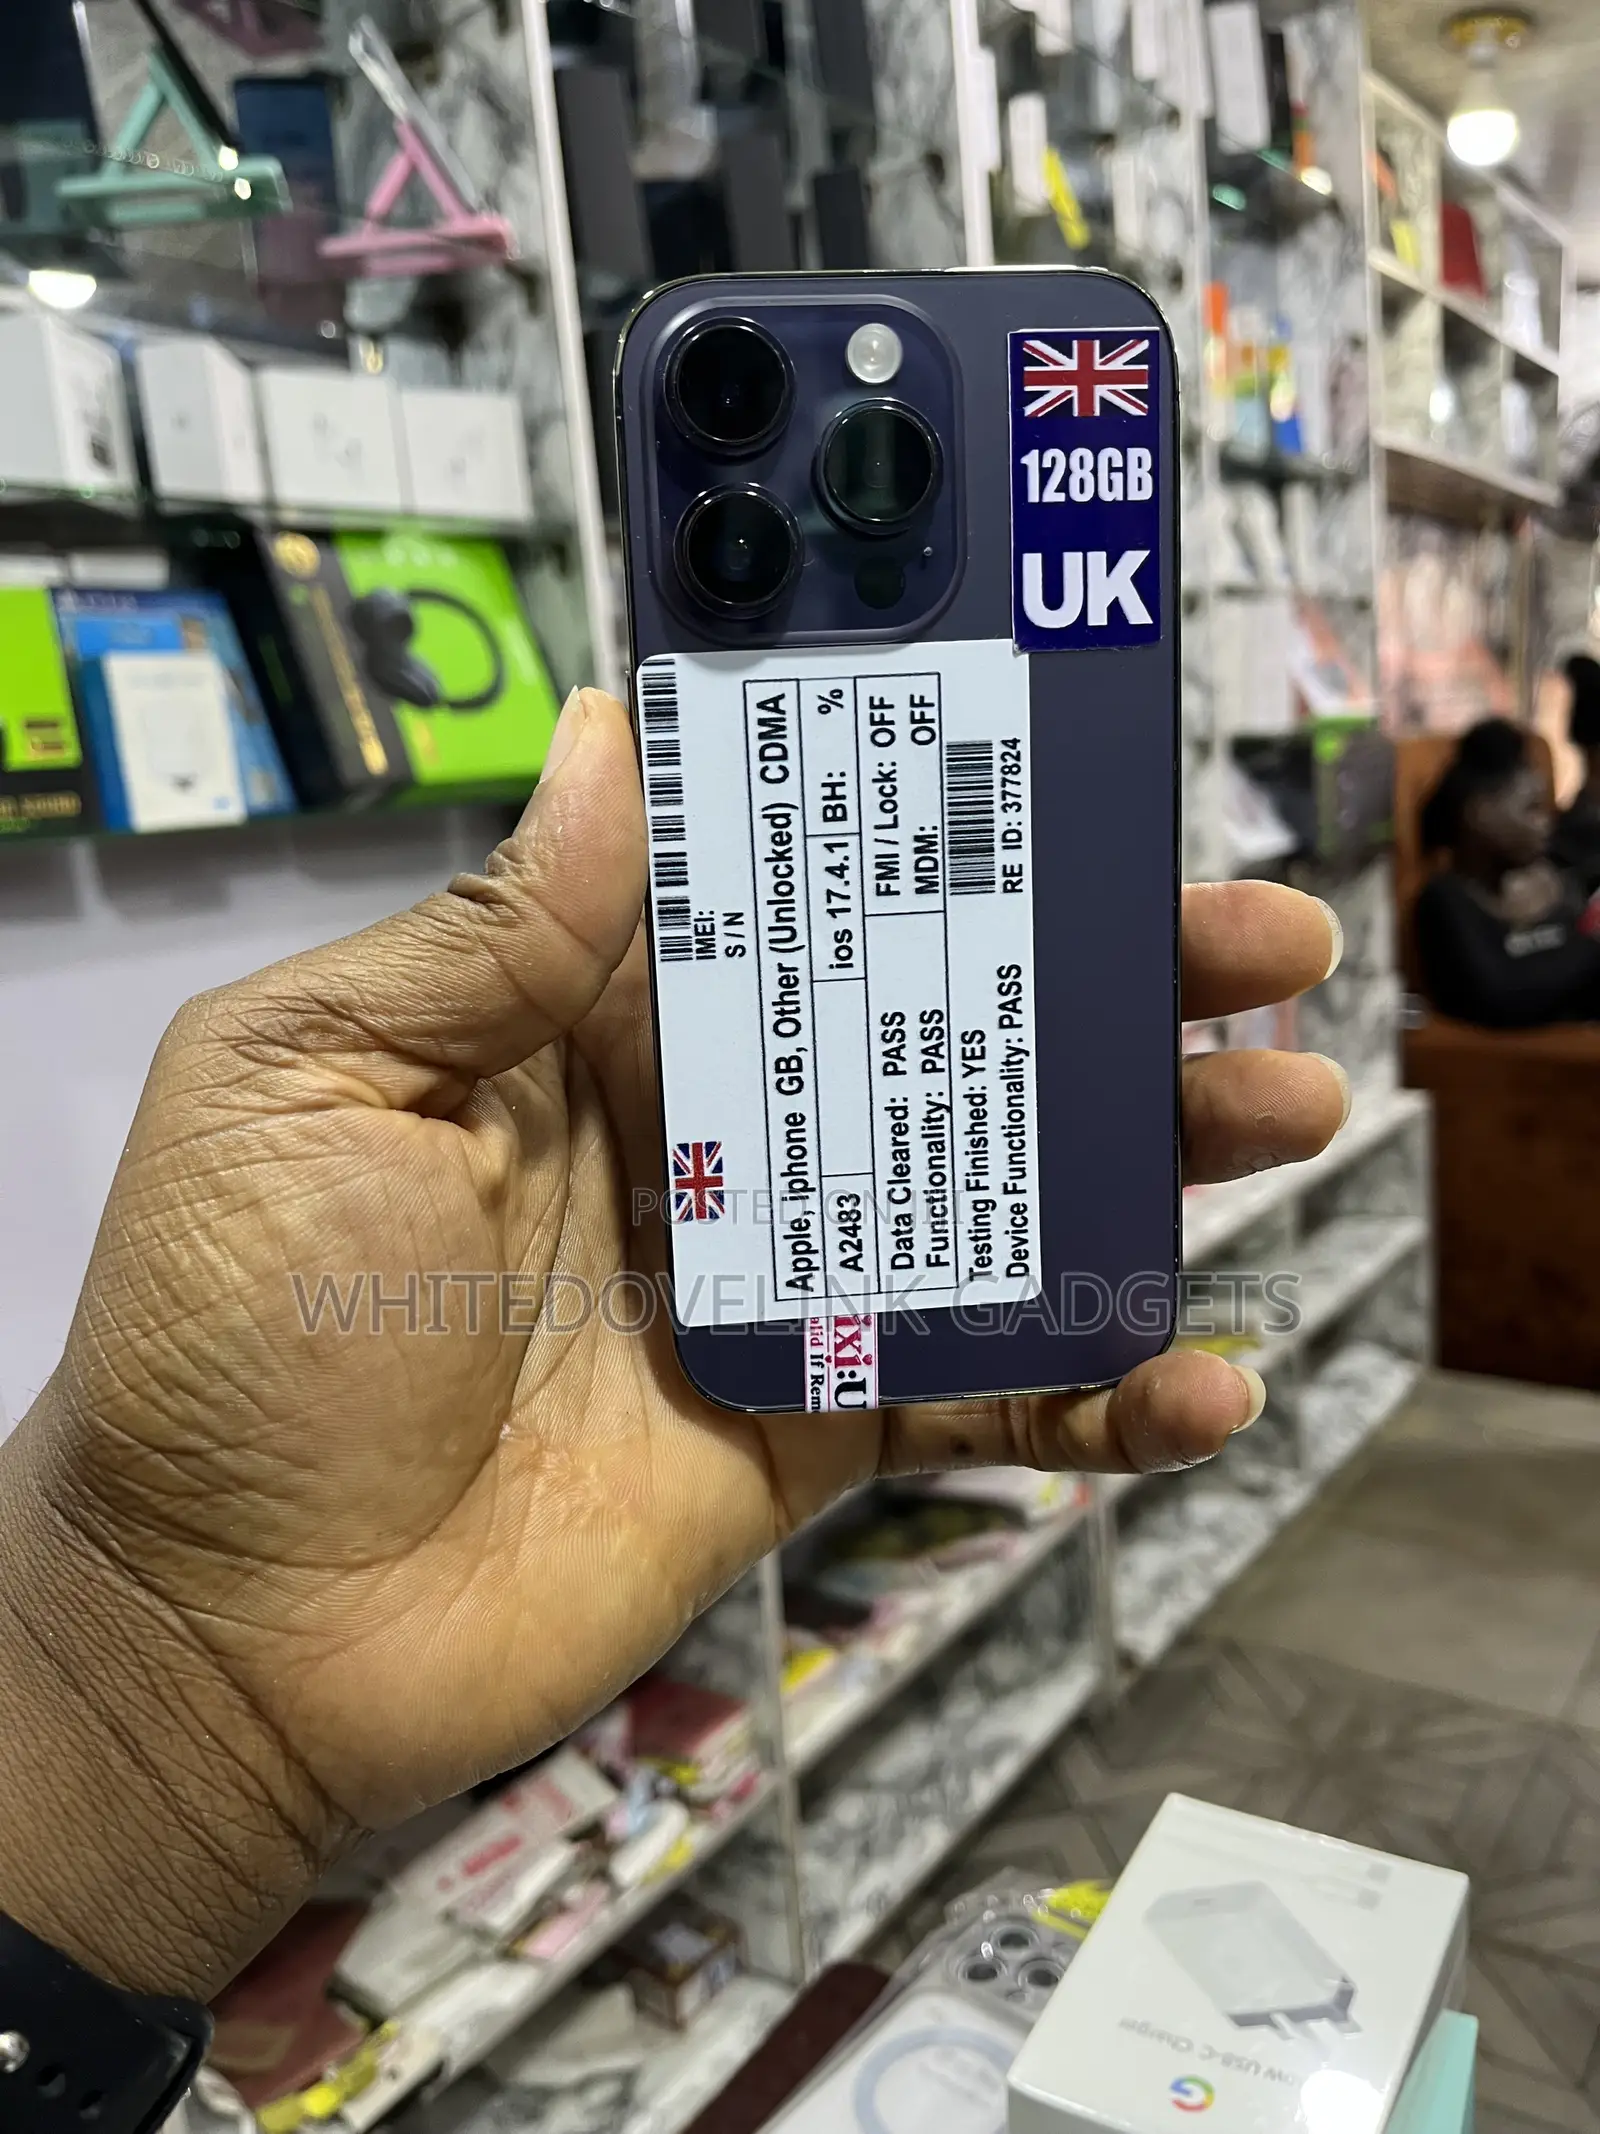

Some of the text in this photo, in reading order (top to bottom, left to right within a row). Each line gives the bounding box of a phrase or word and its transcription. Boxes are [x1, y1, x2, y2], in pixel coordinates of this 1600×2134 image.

[1020, 447, 1153, 503] 128GB
[1022, 549, 1153, 629] UK
[816, 687, 848, 824] BH: %
[868, 694, 897, 749] OFF
[871, 760, 900, 831] Lock:
[909, 693, 940, 895] MDM: OFF
[999, 736, 1025, 895] RE ID: 377824
[693, 909, 717, 961] IMEI:
[823, 841, 854, 970] ios 17.4.1
[874, 852, 901, 897] FMI
[756, 692, 820, 1293] Apple, iphone GB, Other (Unlocked) CDMA
[880, 1010, 916, 1271] Data Cleared: PASS
[919, 1007, 951, 1269] Functionality: PASS
[960, 1028, 998, 1282] Testing Finished: YES
[997, 963, 1031, 1279] Device Functionality: PASS
[836, 1192, 865, 1273] A2483
[809, 1353, 825, 1369] If
